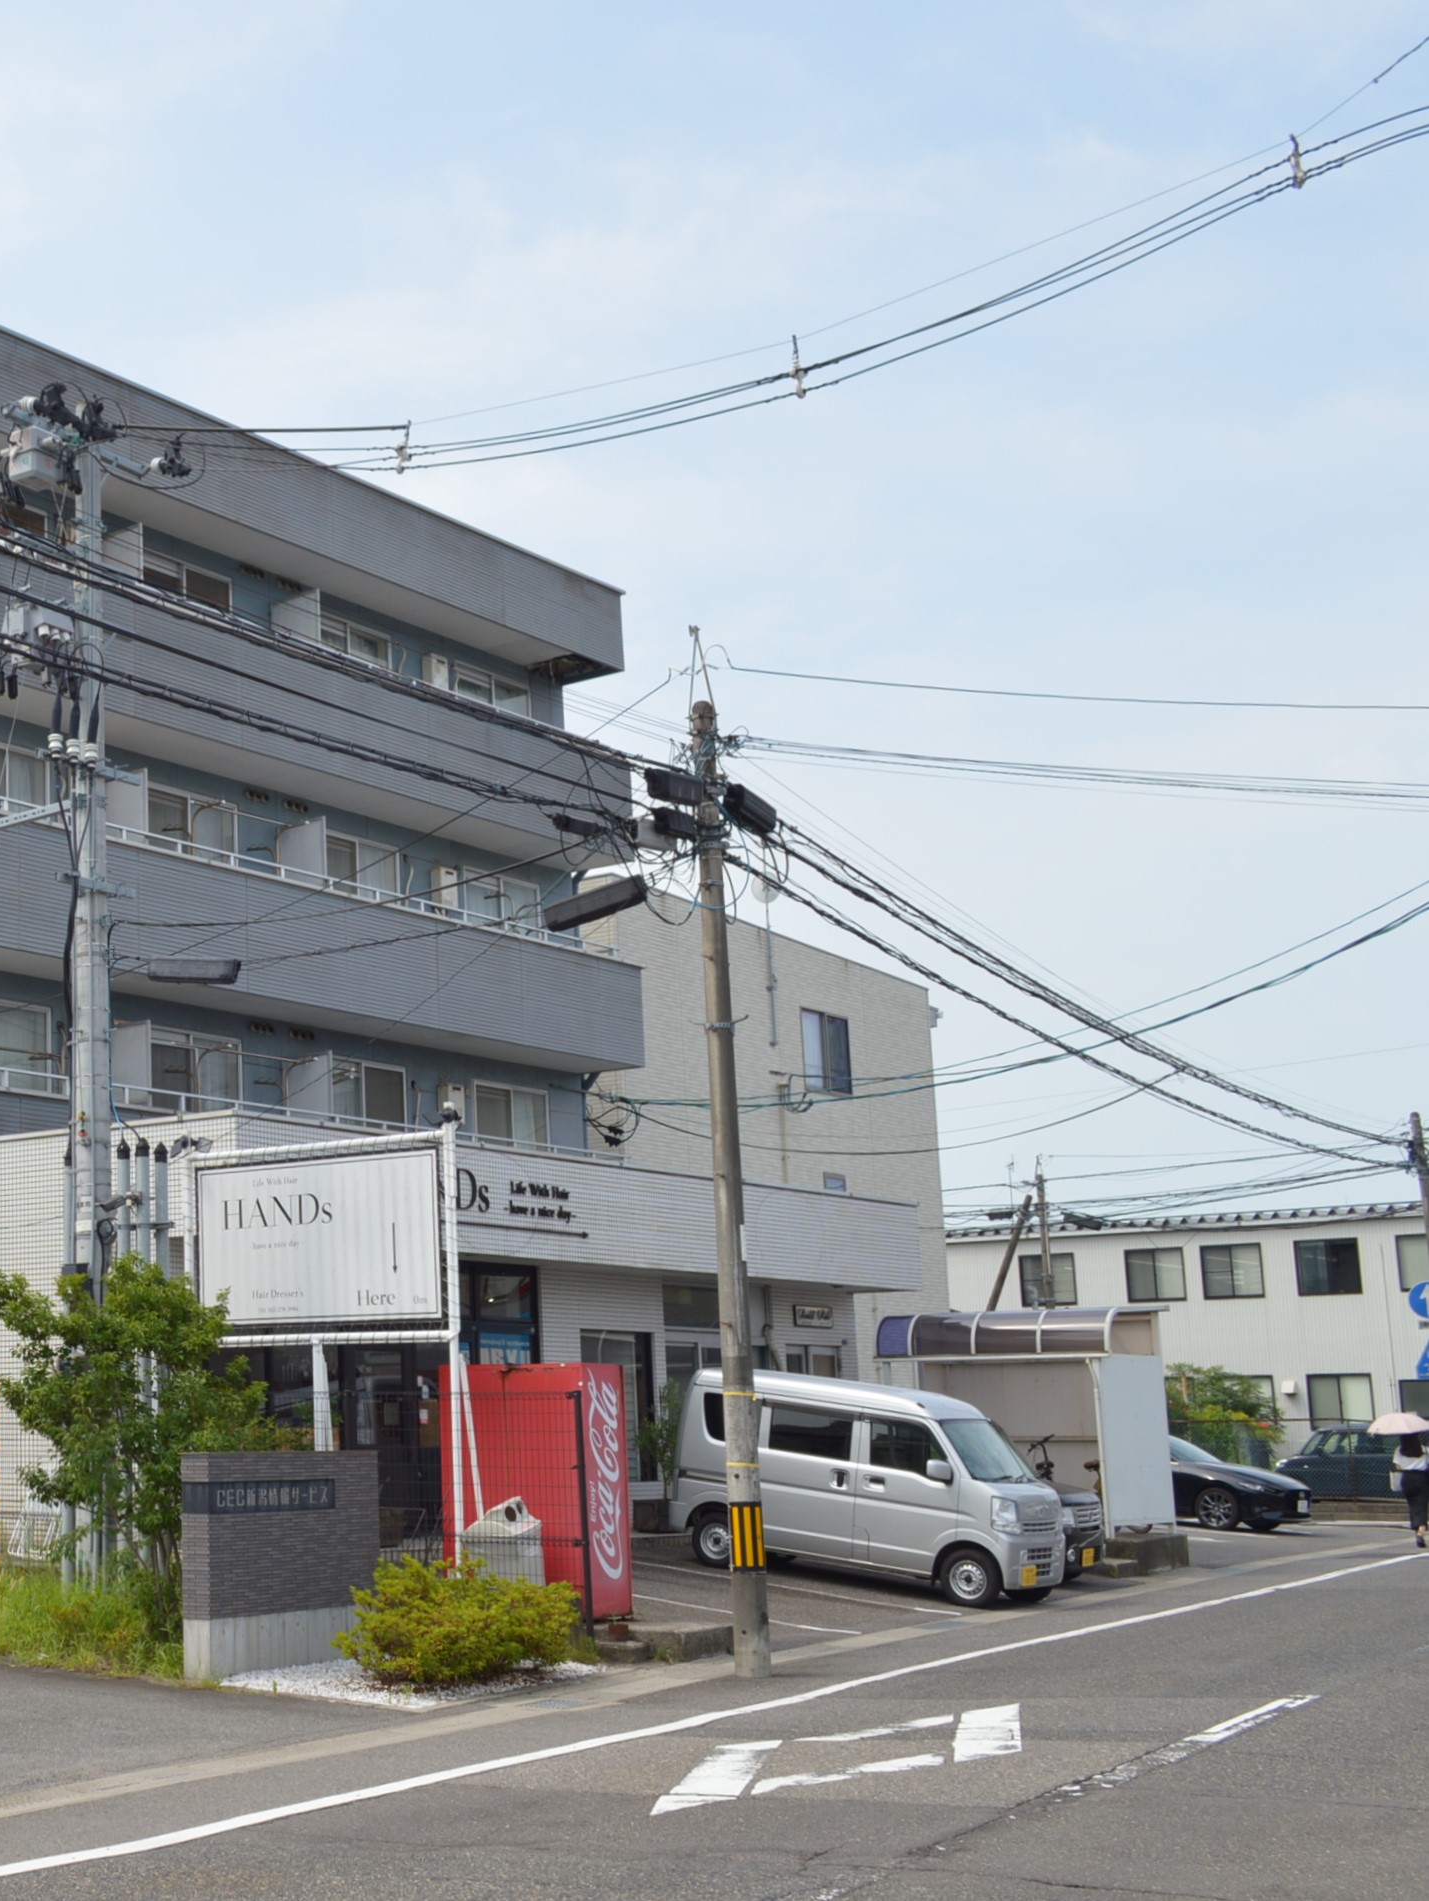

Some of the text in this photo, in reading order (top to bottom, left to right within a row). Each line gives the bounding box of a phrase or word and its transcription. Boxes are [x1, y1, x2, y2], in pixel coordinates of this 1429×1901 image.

[252, 1179, 265, 1188] Life
[510, 1180, 527, 1195] Life
[528, 1182, 550, 1198] With
[221, 1193, 333, 1231] HANDs
[530, 1206, 535, 1216] a
[537, 1206, 555, 1218] nice
[251, 1288, 304, 1300] Hair Dresser's
[356, 1289, 396, 1307] Here
[586, 1367, 624, 1580] Coca-Cola
[589, 1480, 598, 1523] Enjoy!
